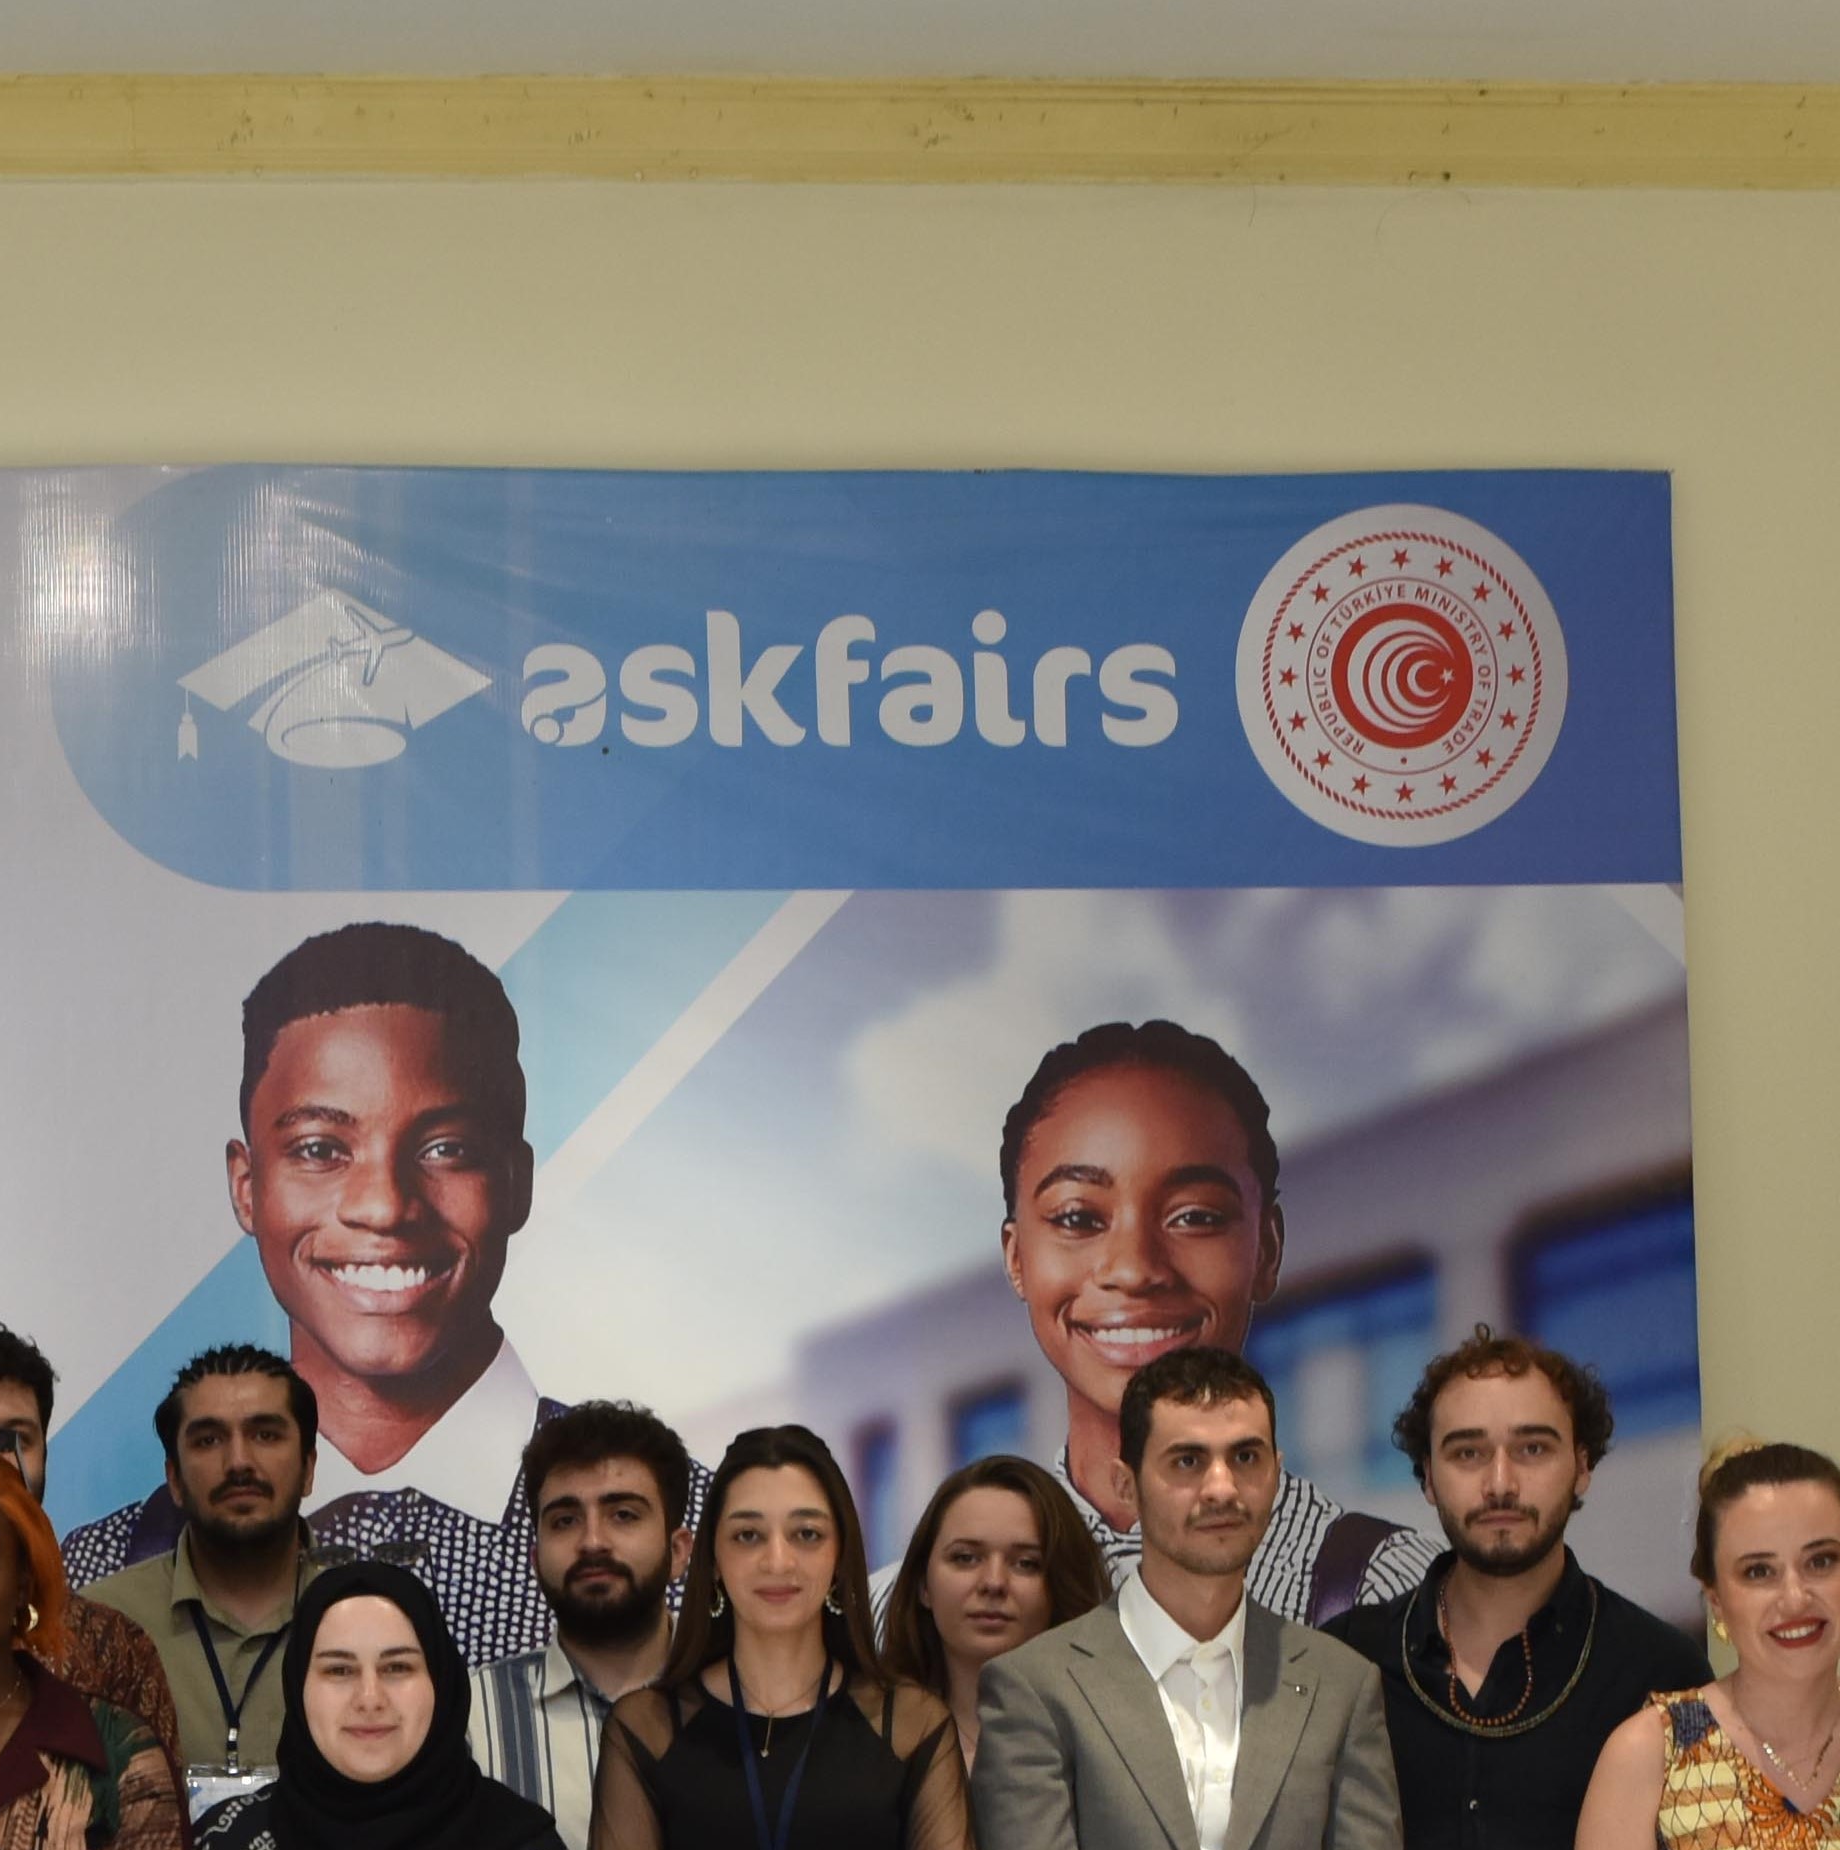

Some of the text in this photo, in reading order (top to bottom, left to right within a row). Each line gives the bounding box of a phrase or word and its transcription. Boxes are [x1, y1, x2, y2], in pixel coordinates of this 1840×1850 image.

[520, 609, 1180, 750] askfairs
[1313, 583, 1491, 755] REPUBLIC OF TÜRKİYE MINISTRY OF TRADE
